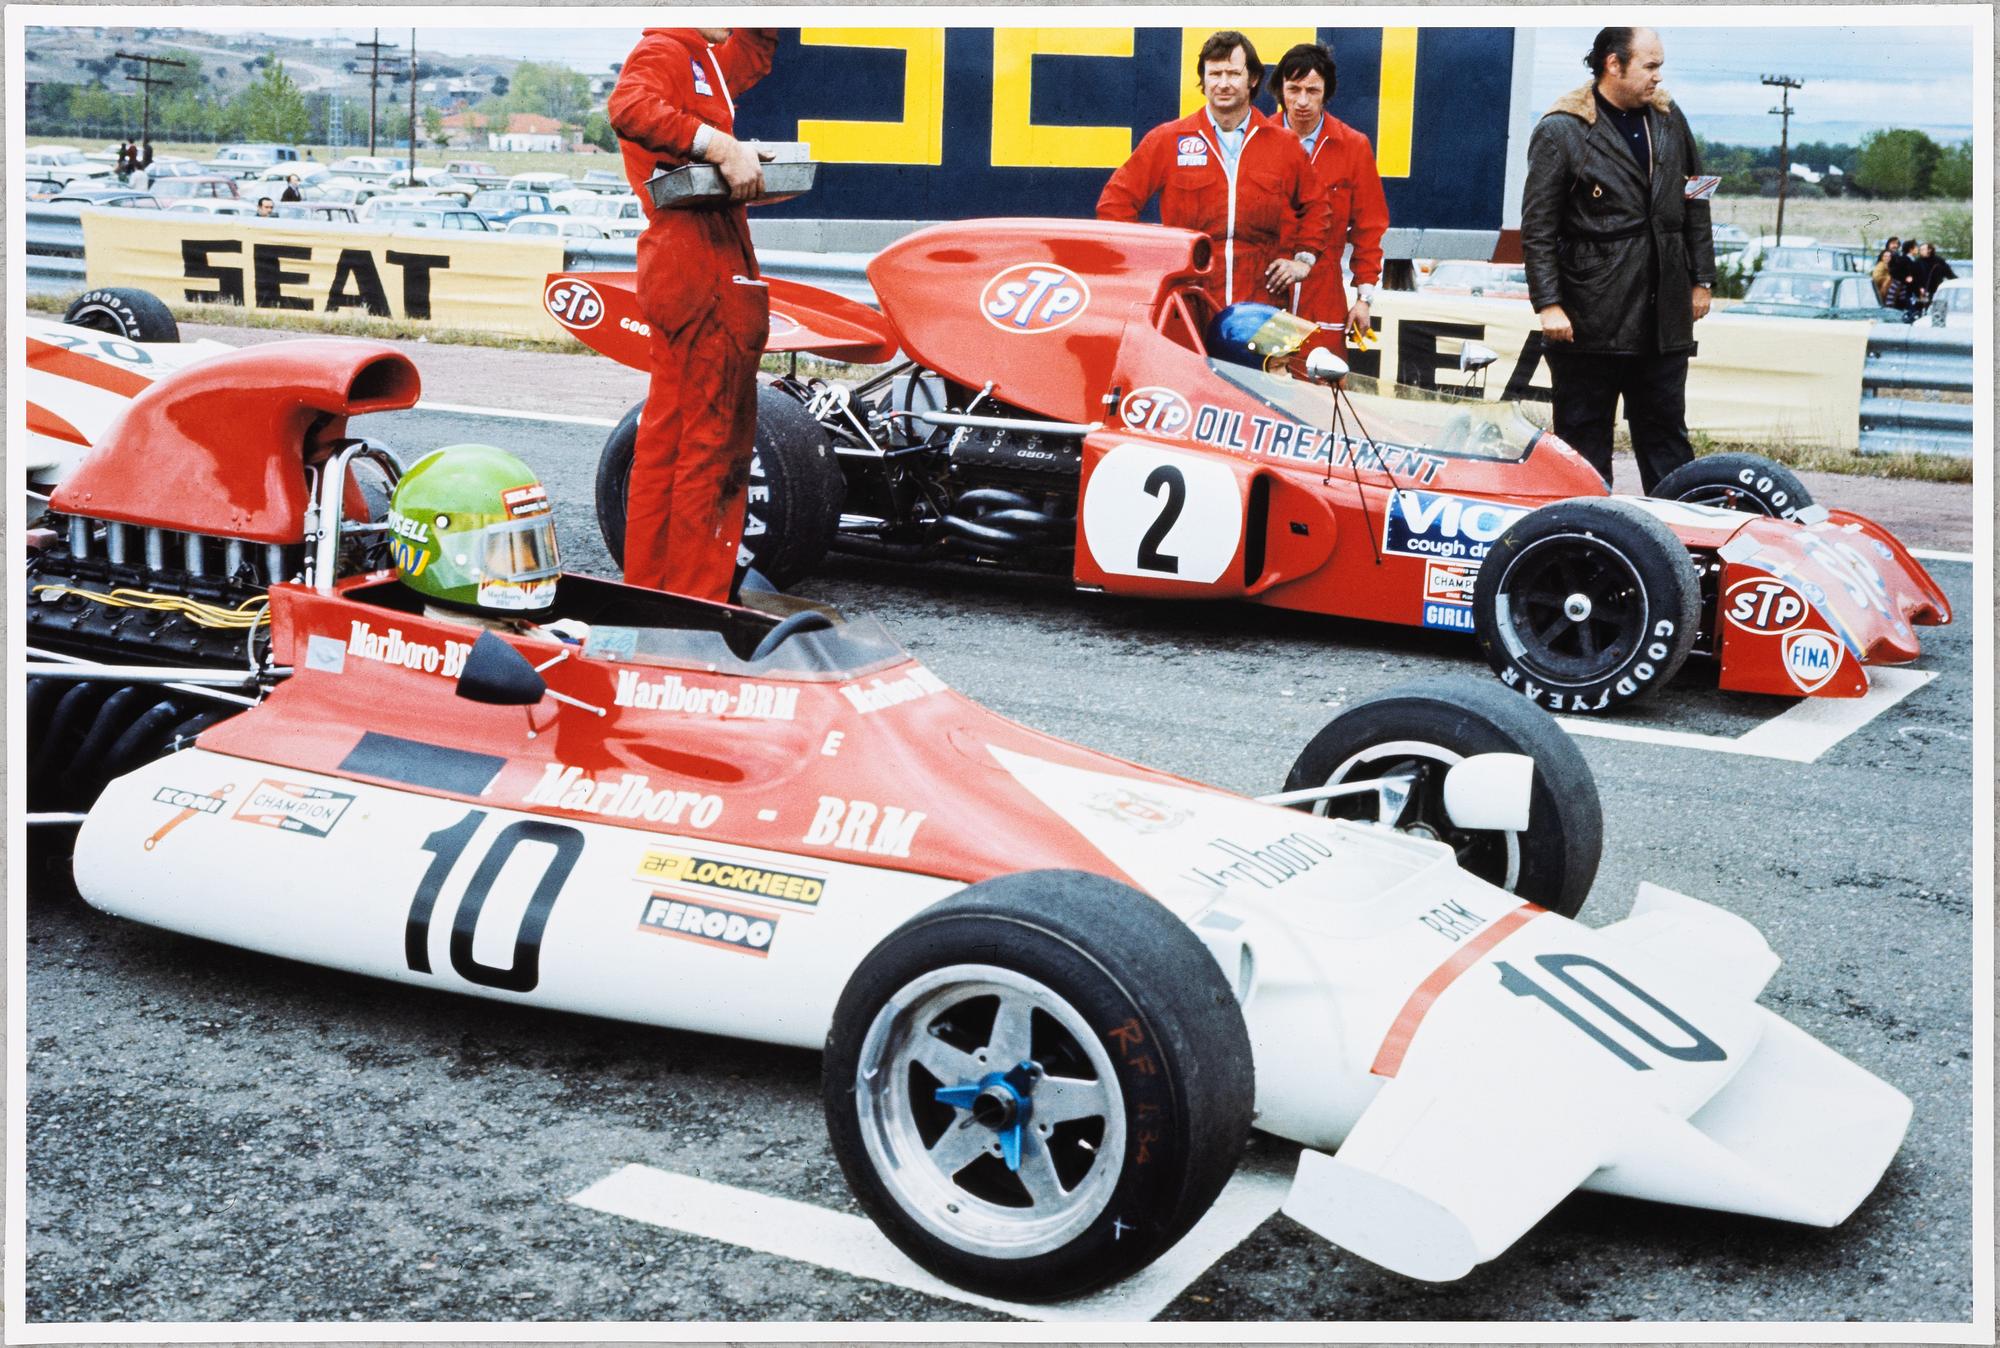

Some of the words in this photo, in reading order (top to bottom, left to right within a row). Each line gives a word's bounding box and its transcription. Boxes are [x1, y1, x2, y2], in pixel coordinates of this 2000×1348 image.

[181, 240, 450, 320] SEAT
[551, 284, 599, 321] STP
[992, 267, 1082, 328] STP
[619, 317, 651, 337] GOO
[1126, 395, 1185, 431] STP
[1193, 403, 1246, 453] OIL
[1248, 415, 1447, 486] TREATMENT
[1137, 464, 1184, 575] 2
[1407, 537, 1465, 558] cough
[1426, 605, 1475, 630] GIRLI
[1731, 583, 1801, 628] STP
[1500, 618, 1675, 712] GOODYEAR
[1793, 645, 1830, 670] FINA
[613, 670, 800, 720] Marlboro-BRM
[820, 730, 845, 757] E
[156, 787, 223, 814] KONI
[252, 794, 337, 820] CHAMPION
[522, 763, 724, 829] Marlboro
[803, 796, 927, 859] BRM
[405, 809, 586, 993] 10
[681, 858, 824, 903] LOCKHEED
[645, 898, 773, 948] FERODO
[1418, 898, 1487, 942] BRM
[1491, 953, 1728, 1072] 10
